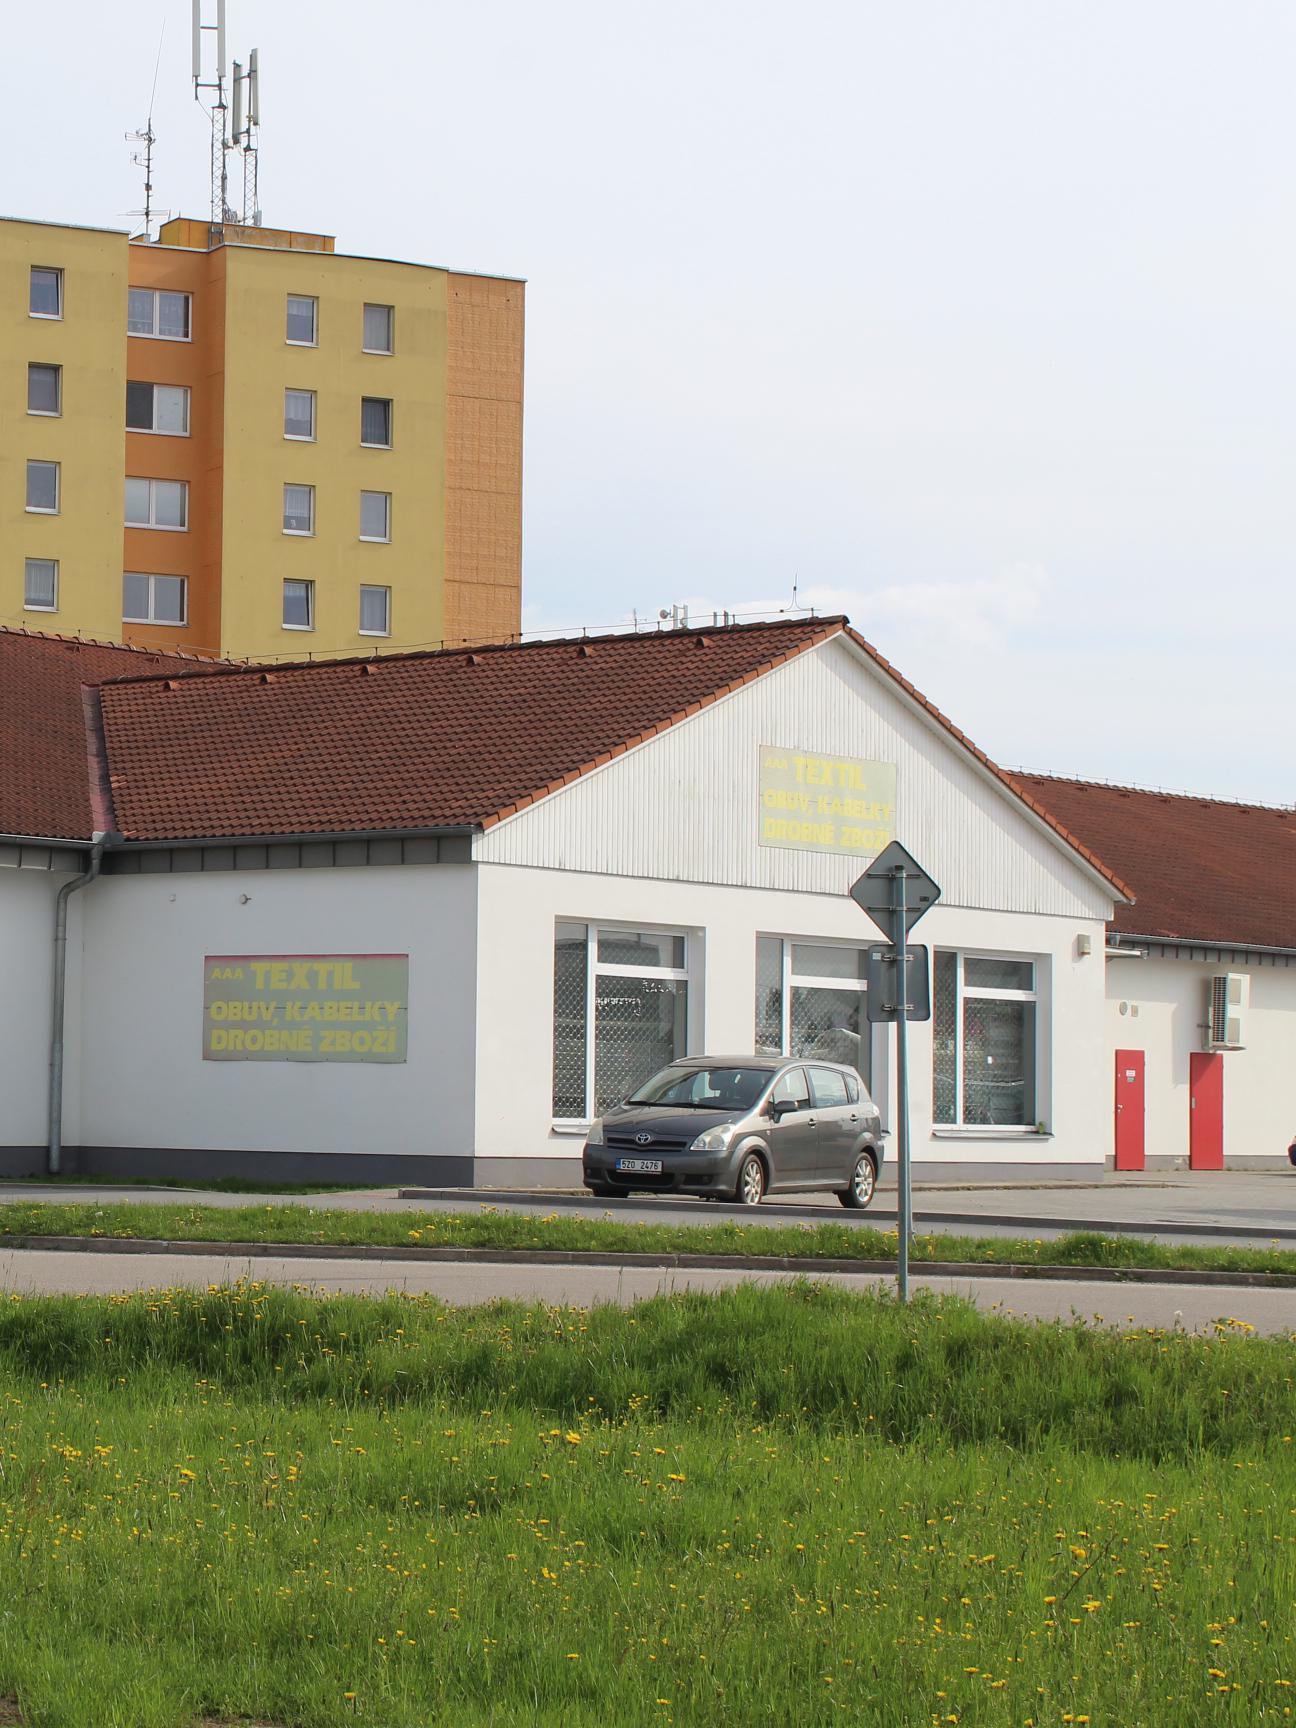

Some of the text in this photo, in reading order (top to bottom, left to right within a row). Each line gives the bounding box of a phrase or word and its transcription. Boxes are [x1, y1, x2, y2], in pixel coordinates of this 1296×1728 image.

[793, 756, 867, 791] TEXTIL
[816, 794, 892, 822] KABELKY
[763, 816, 834, 845] DROBNÉ
[211, 962, 360, 990] AAA TEXTIL
[209, 1001, 401, 1025] OBUV, KABELKY
[210, 1026, 399, 1053] DROBNÉ ZBOŽÍ
